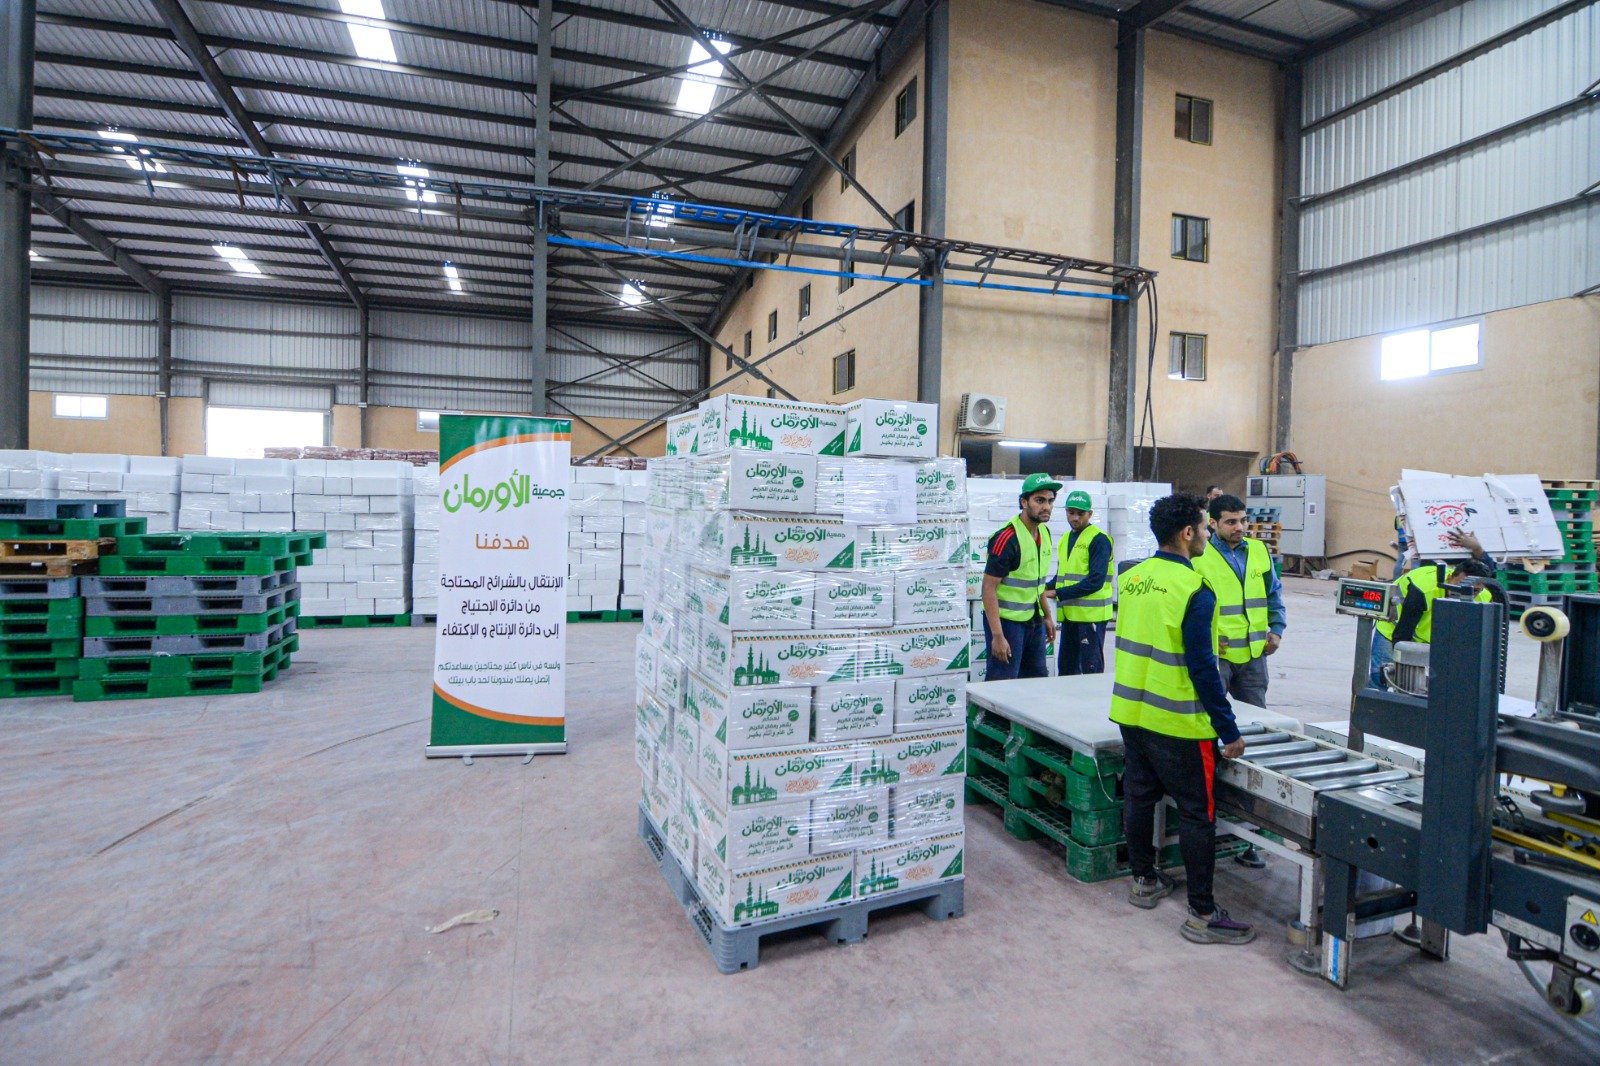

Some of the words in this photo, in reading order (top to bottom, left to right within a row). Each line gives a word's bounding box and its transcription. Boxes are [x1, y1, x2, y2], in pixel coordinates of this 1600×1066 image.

[771, 414, 818, 430] الأورمان
[876, 412, 911, 426] الأورمان
[746, 463, 787, 479] الأورمان
[444, 469, 530, 513] الأورمان
[532, 484, 565, 499] جمعية
[476, 533, 529, 549] هدفنا
[775, 527, 826, 543] الأورمان
[441, 574, 485, 591] المحتاجة
[487, 574, 526, 591] بالشرائح
[529, 575, 563, 591] الإنتقال
[829, 582, 866, 599] الأورمان
[462, 600, 497, 615] الإحتياج
[500, 599, 522, 614] دائرة
[525, 600, 540, 614] من
[442, 623, 479, 639] الإكتفاء
[481, 628, 487, 637] و
[490, 624, 516, 639] الإنتاج
[520, 623, 540, 637] دائرة
[543, 624, 559, 638] إلى
[778, 642, 827, 660] الأورمان
[901, 634, 945, 652] الأورمان
[438, 662, 473, 671] مساعدتكم
[475, 662, 502, 671] محتاجين
[504, 662, 517, 670] كتير
[519, 661, 531, 670] ناس
[448, 676, 464, 686] بيتك
[466, 676, 476, 685] باب
[491, 676, 513, 685] مندوبنا
[909, 685, 942, 703] الأورمان
[743, 700, 782, 718] الأورمان
[831, 694, 868, 712] الأورمان
[898, 740, 941, 760] الأورمان
[775, 755, 824, 776] الأورمان
[742, 815, 782, 836] الأورمان
[897, 844, 939, 866] الأورمان
[777, 866, 825, 889] الأورمان
